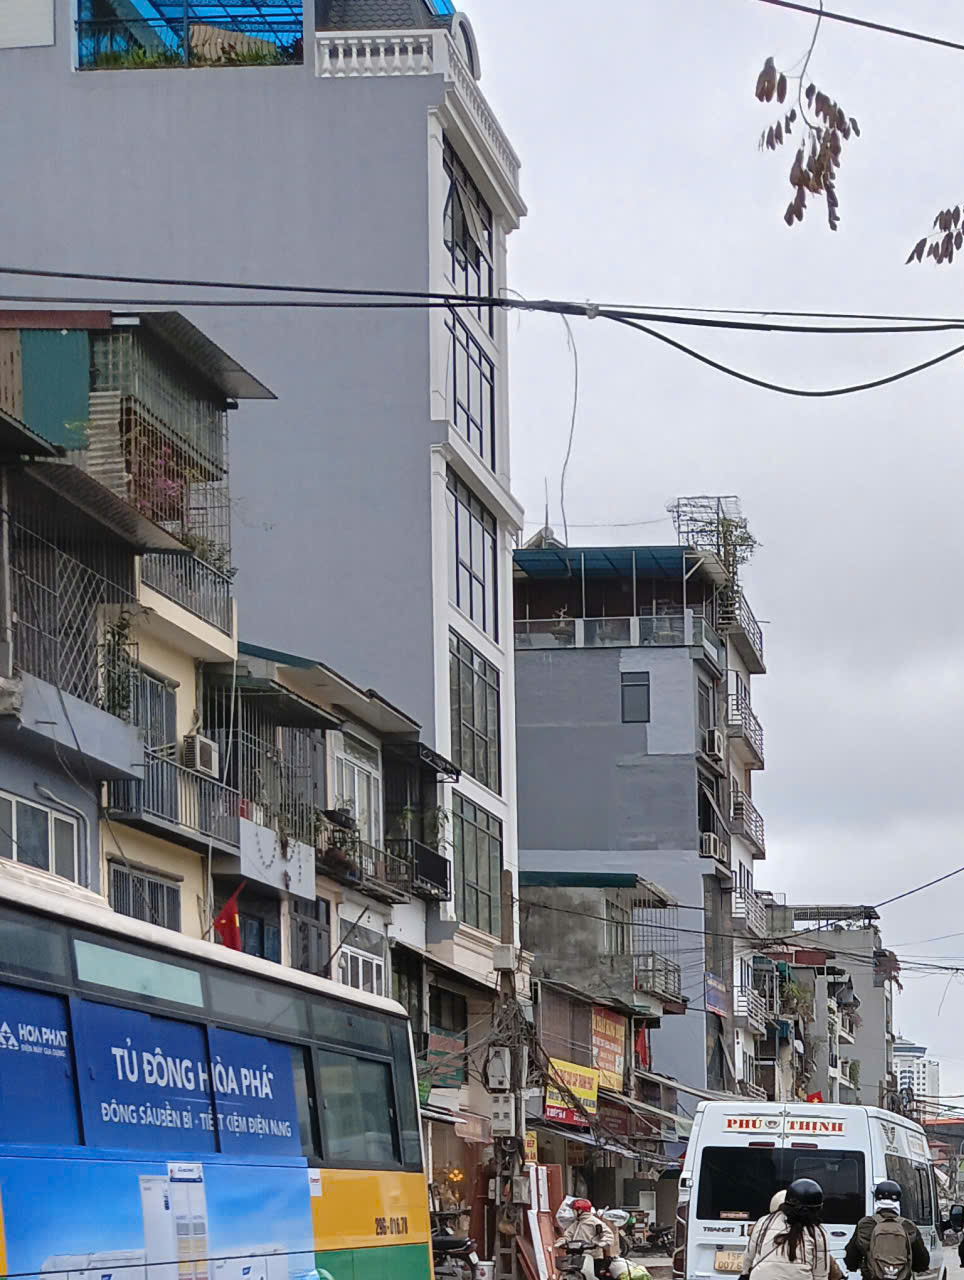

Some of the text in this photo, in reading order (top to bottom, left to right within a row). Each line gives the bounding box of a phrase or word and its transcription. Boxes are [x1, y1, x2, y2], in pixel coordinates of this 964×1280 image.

[111, 1037, 139, 1083] TỦ
[142, 1047, 196, 1091] ĐÔNG
[100, 1099, 138, 1124] ĐÔNG
[726, 1117, 844, 1133] PHÚ THỊNH
